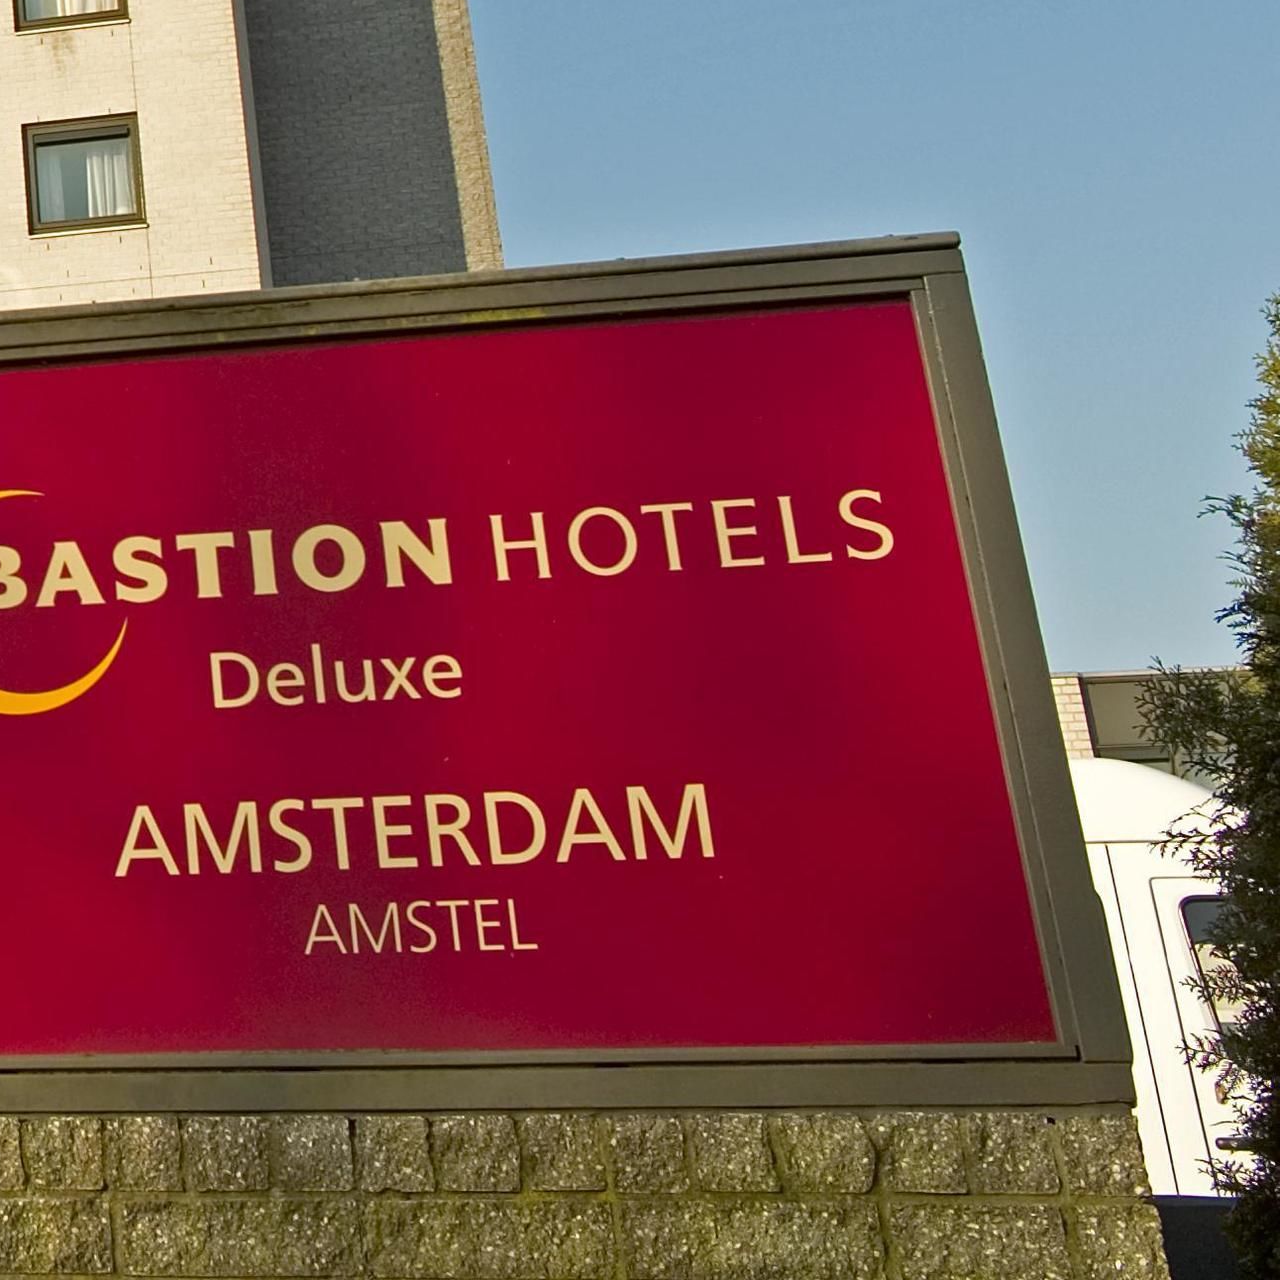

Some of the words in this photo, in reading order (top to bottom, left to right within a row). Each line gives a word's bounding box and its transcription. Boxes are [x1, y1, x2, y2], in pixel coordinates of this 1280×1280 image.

[489, 489, 895, 581] HOTELS
[209, 643, 463, 708] Deluxe
[114, 783, 715, 877] AMSTERDAM
[304, 899, 539, 955] AMSTEL
